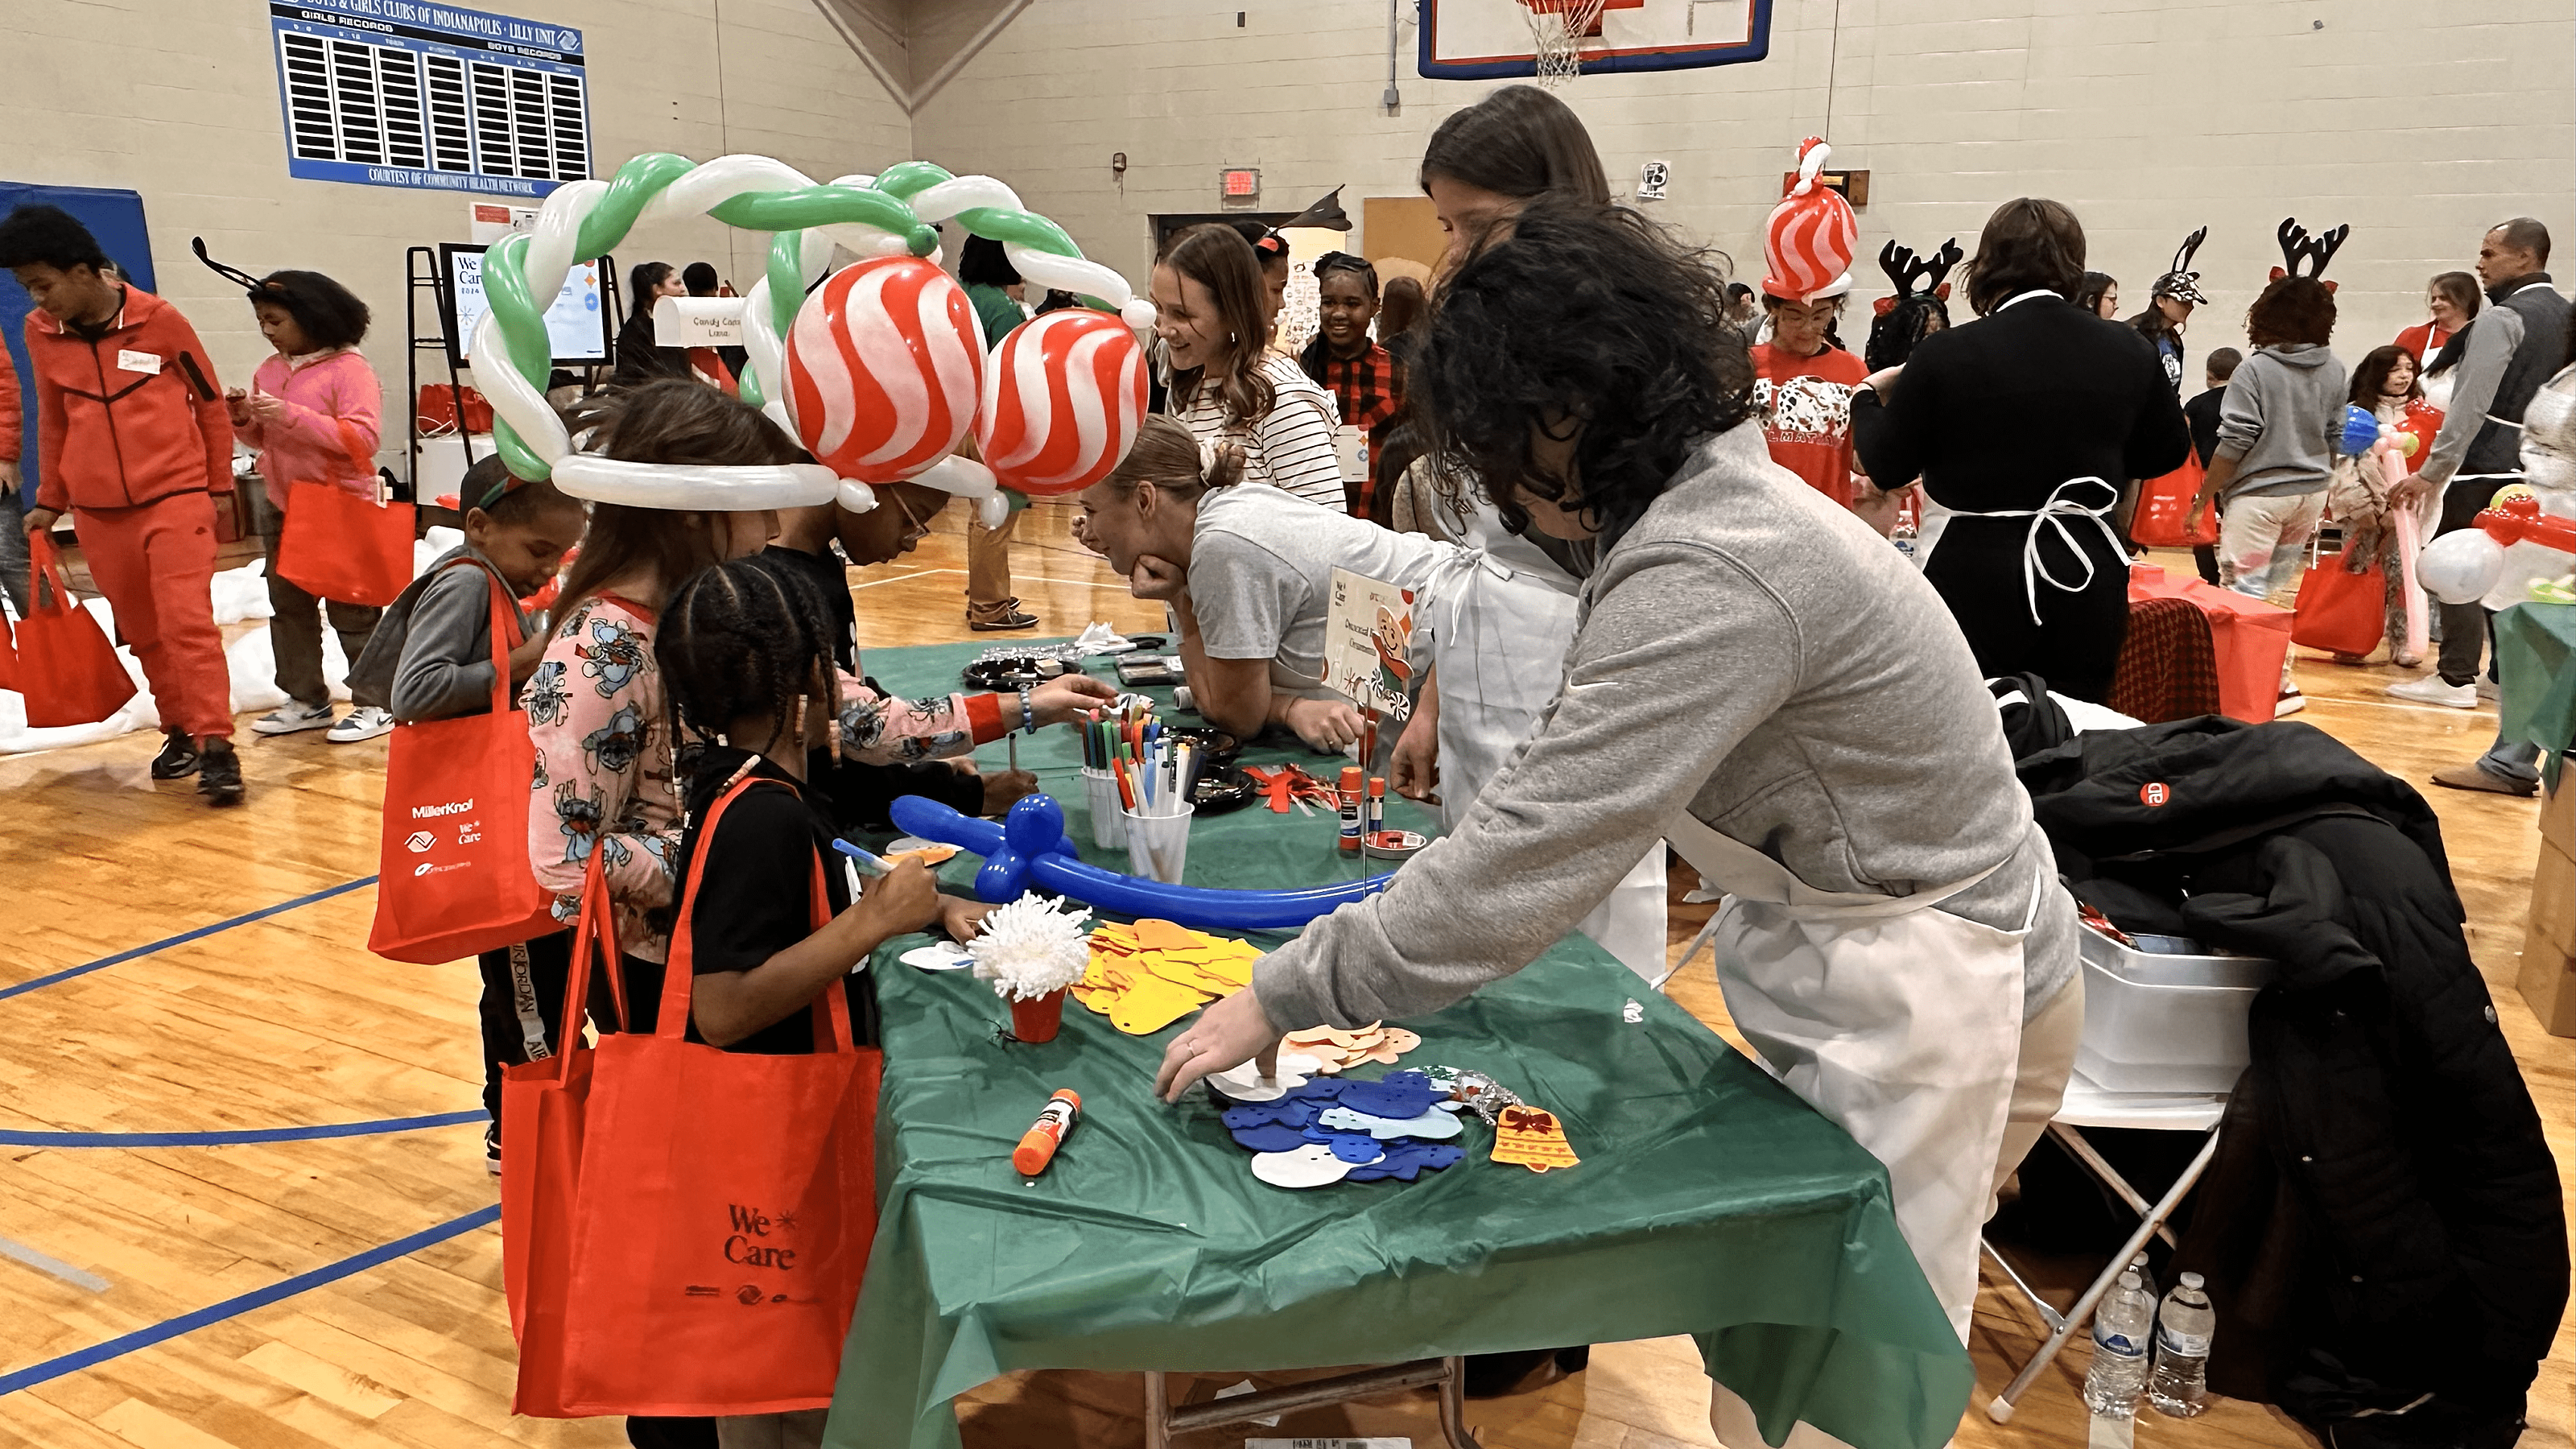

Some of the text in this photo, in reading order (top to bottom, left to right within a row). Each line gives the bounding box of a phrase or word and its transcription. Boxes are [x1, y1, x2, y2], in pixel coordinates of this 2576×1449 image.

[350, 0, 381, 14] GIRLS
[384, 0, 415, 22] CLUBS
[418, 6, 431, 25] OF
[433, 9, 502, 35] INDIANAPOLIS
[509, 23, 534, 42] LILLY
[369, 167, 410, 184] COURTESY
[411, 171, 422, 185] OF
[458, 256, 477, 270] We
[459, 271, 482, 285] Car
[458, 832, 481, 845] Care
[512, 960, 535, 1013] JORDAN
[729, 1203, 771, 1236] We
[724, 1235, 796, 1271] Care
